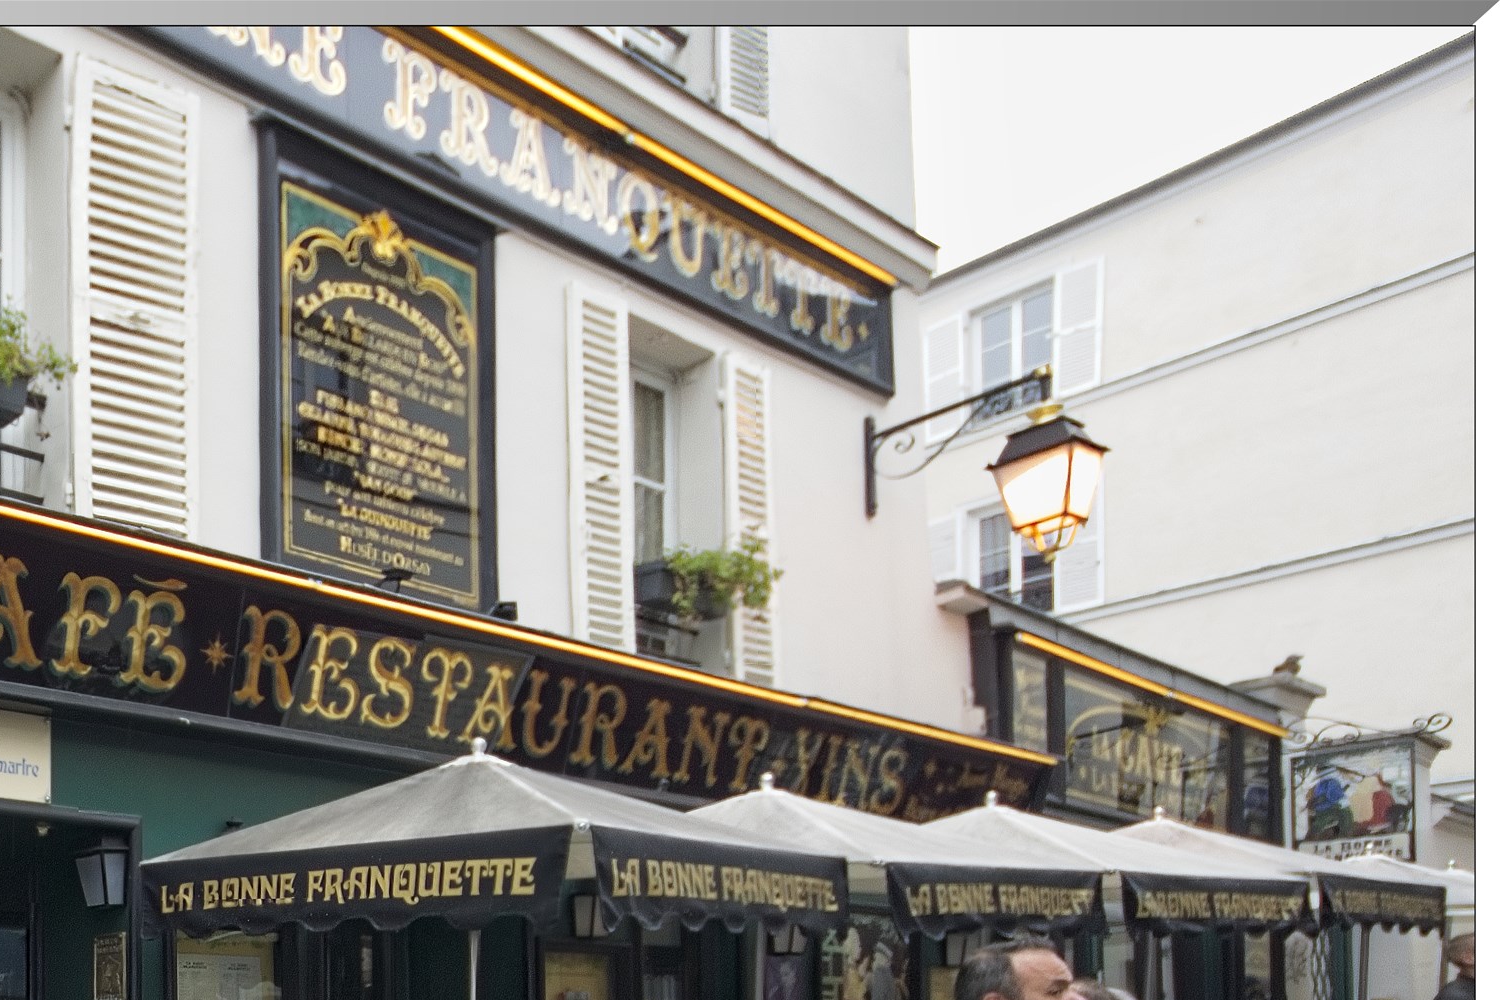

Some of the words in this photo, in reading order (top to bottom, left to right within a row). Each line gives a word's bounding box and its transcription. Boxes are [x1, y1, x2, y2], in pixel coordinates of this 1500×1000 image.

[382, 35, 854, 353] FRANQUETTE
[232, 605, 770, 792] RESTAURANT
[794, 727, 908, 816] VINS
[160, 882, 194, 914] LA
[202, 872, 297, 911] BONNE
[306, 856, 539, 906] FRANQUETTE
[611, 858, 641, 898] LA
[646, 859, 718, 900] BONNE
[720, 866, 840, 913] FRANQUETTE
[906, 883, 932, 917] LA
[935, 882, 998, 915] BONNE
